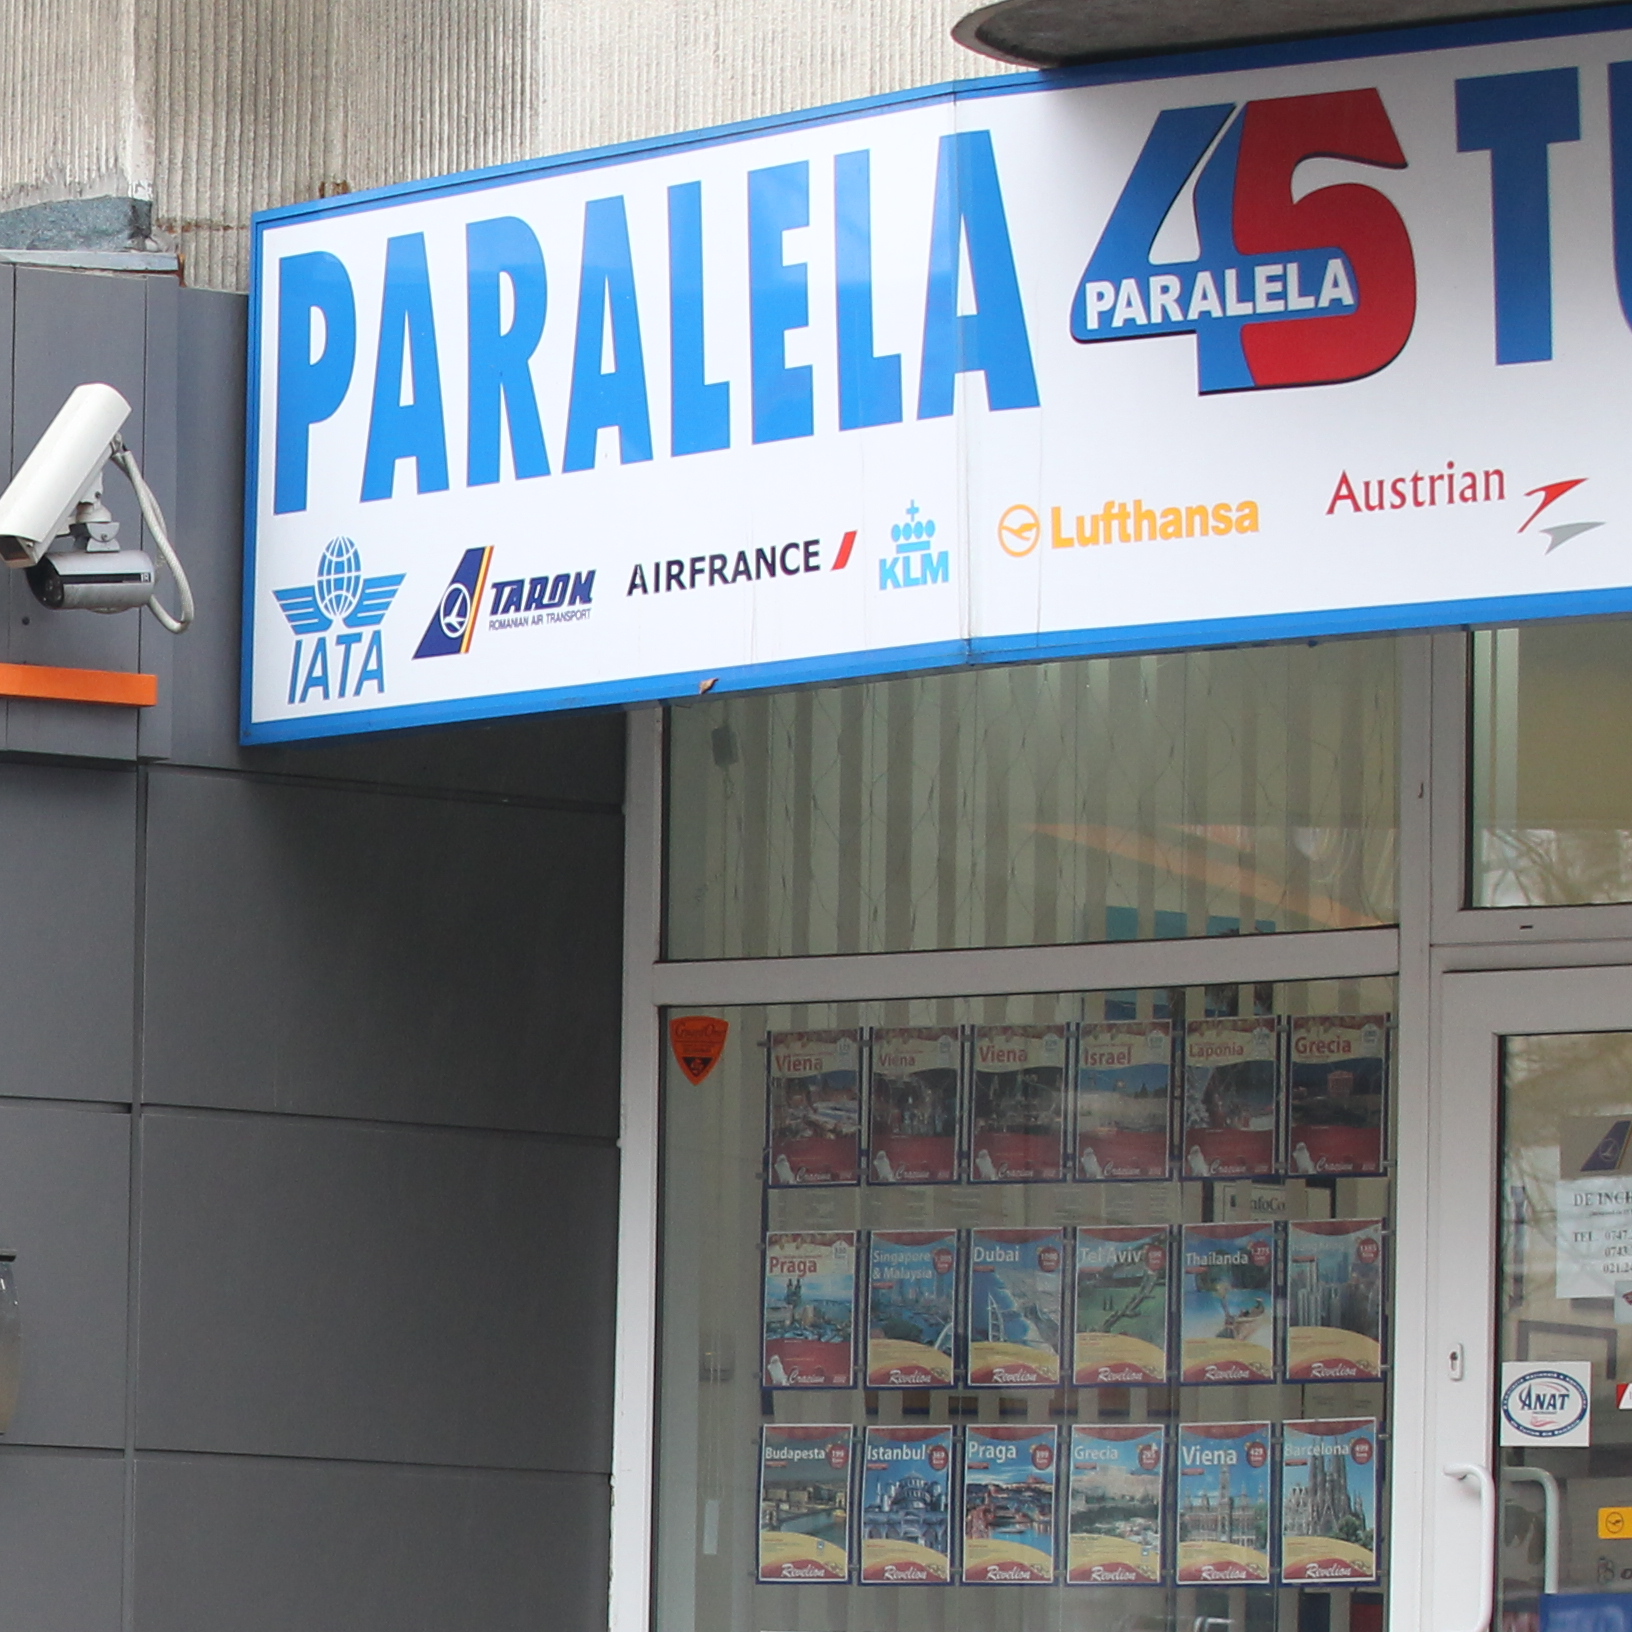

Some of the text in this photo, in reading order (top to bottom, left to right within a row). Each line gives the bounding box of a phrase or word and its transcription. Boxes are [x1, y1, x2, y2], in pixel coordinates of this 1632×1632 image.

[273, 129, 1041, 516] PARALELA
[1454, 61, 1632, 366] T
[1085, 257, 1355, 330] PARALELA
[1326, 461, 1506, 516] Austrian
[1051, 499, 1259, 550] Lufthansa
[879, 551, 949, 591] KLM
[489, 569, 597, 616] TAROM
[489, 607, 592, 631] ROMANIAN AIR TRANSPORT
[287, 629, 386, 705] IATA
[979, 1045, 1028, 1063] Viena
[1189, 1042, 1244, 1060] Laponia
[1294, 1036, 1352, 1055] Grecia
[775, 1053, 824, 1072] Viena
[880, 1053, 916, 1067] Viena
[1084, 1046, 1132, 1066] Israel
[873, 1250, 931, 1265] Singapore
[973, 1245, 1020, 1262] Dubai
[1107, 1247, 1142, 1263] Aviv
[1186, 1252, 1249, 1267] Thailanda
[769, 1256, 818, 1277] Praga
[883, 1266, 934, 1282] Malaysia
[1518, 1383, 1571, 1411] ANAT
[765, 1446, 825, 1461] Budapesta
[867, 1444, 925, 1461] Istanbul
[968, 1441, 1017, 1463] Praga
[1074, 1445, 1119, 1460] Grecia
[1182, 1446, 1237, 1466] Viena
[1284, 1442, 1350, 1457] Barcelona
